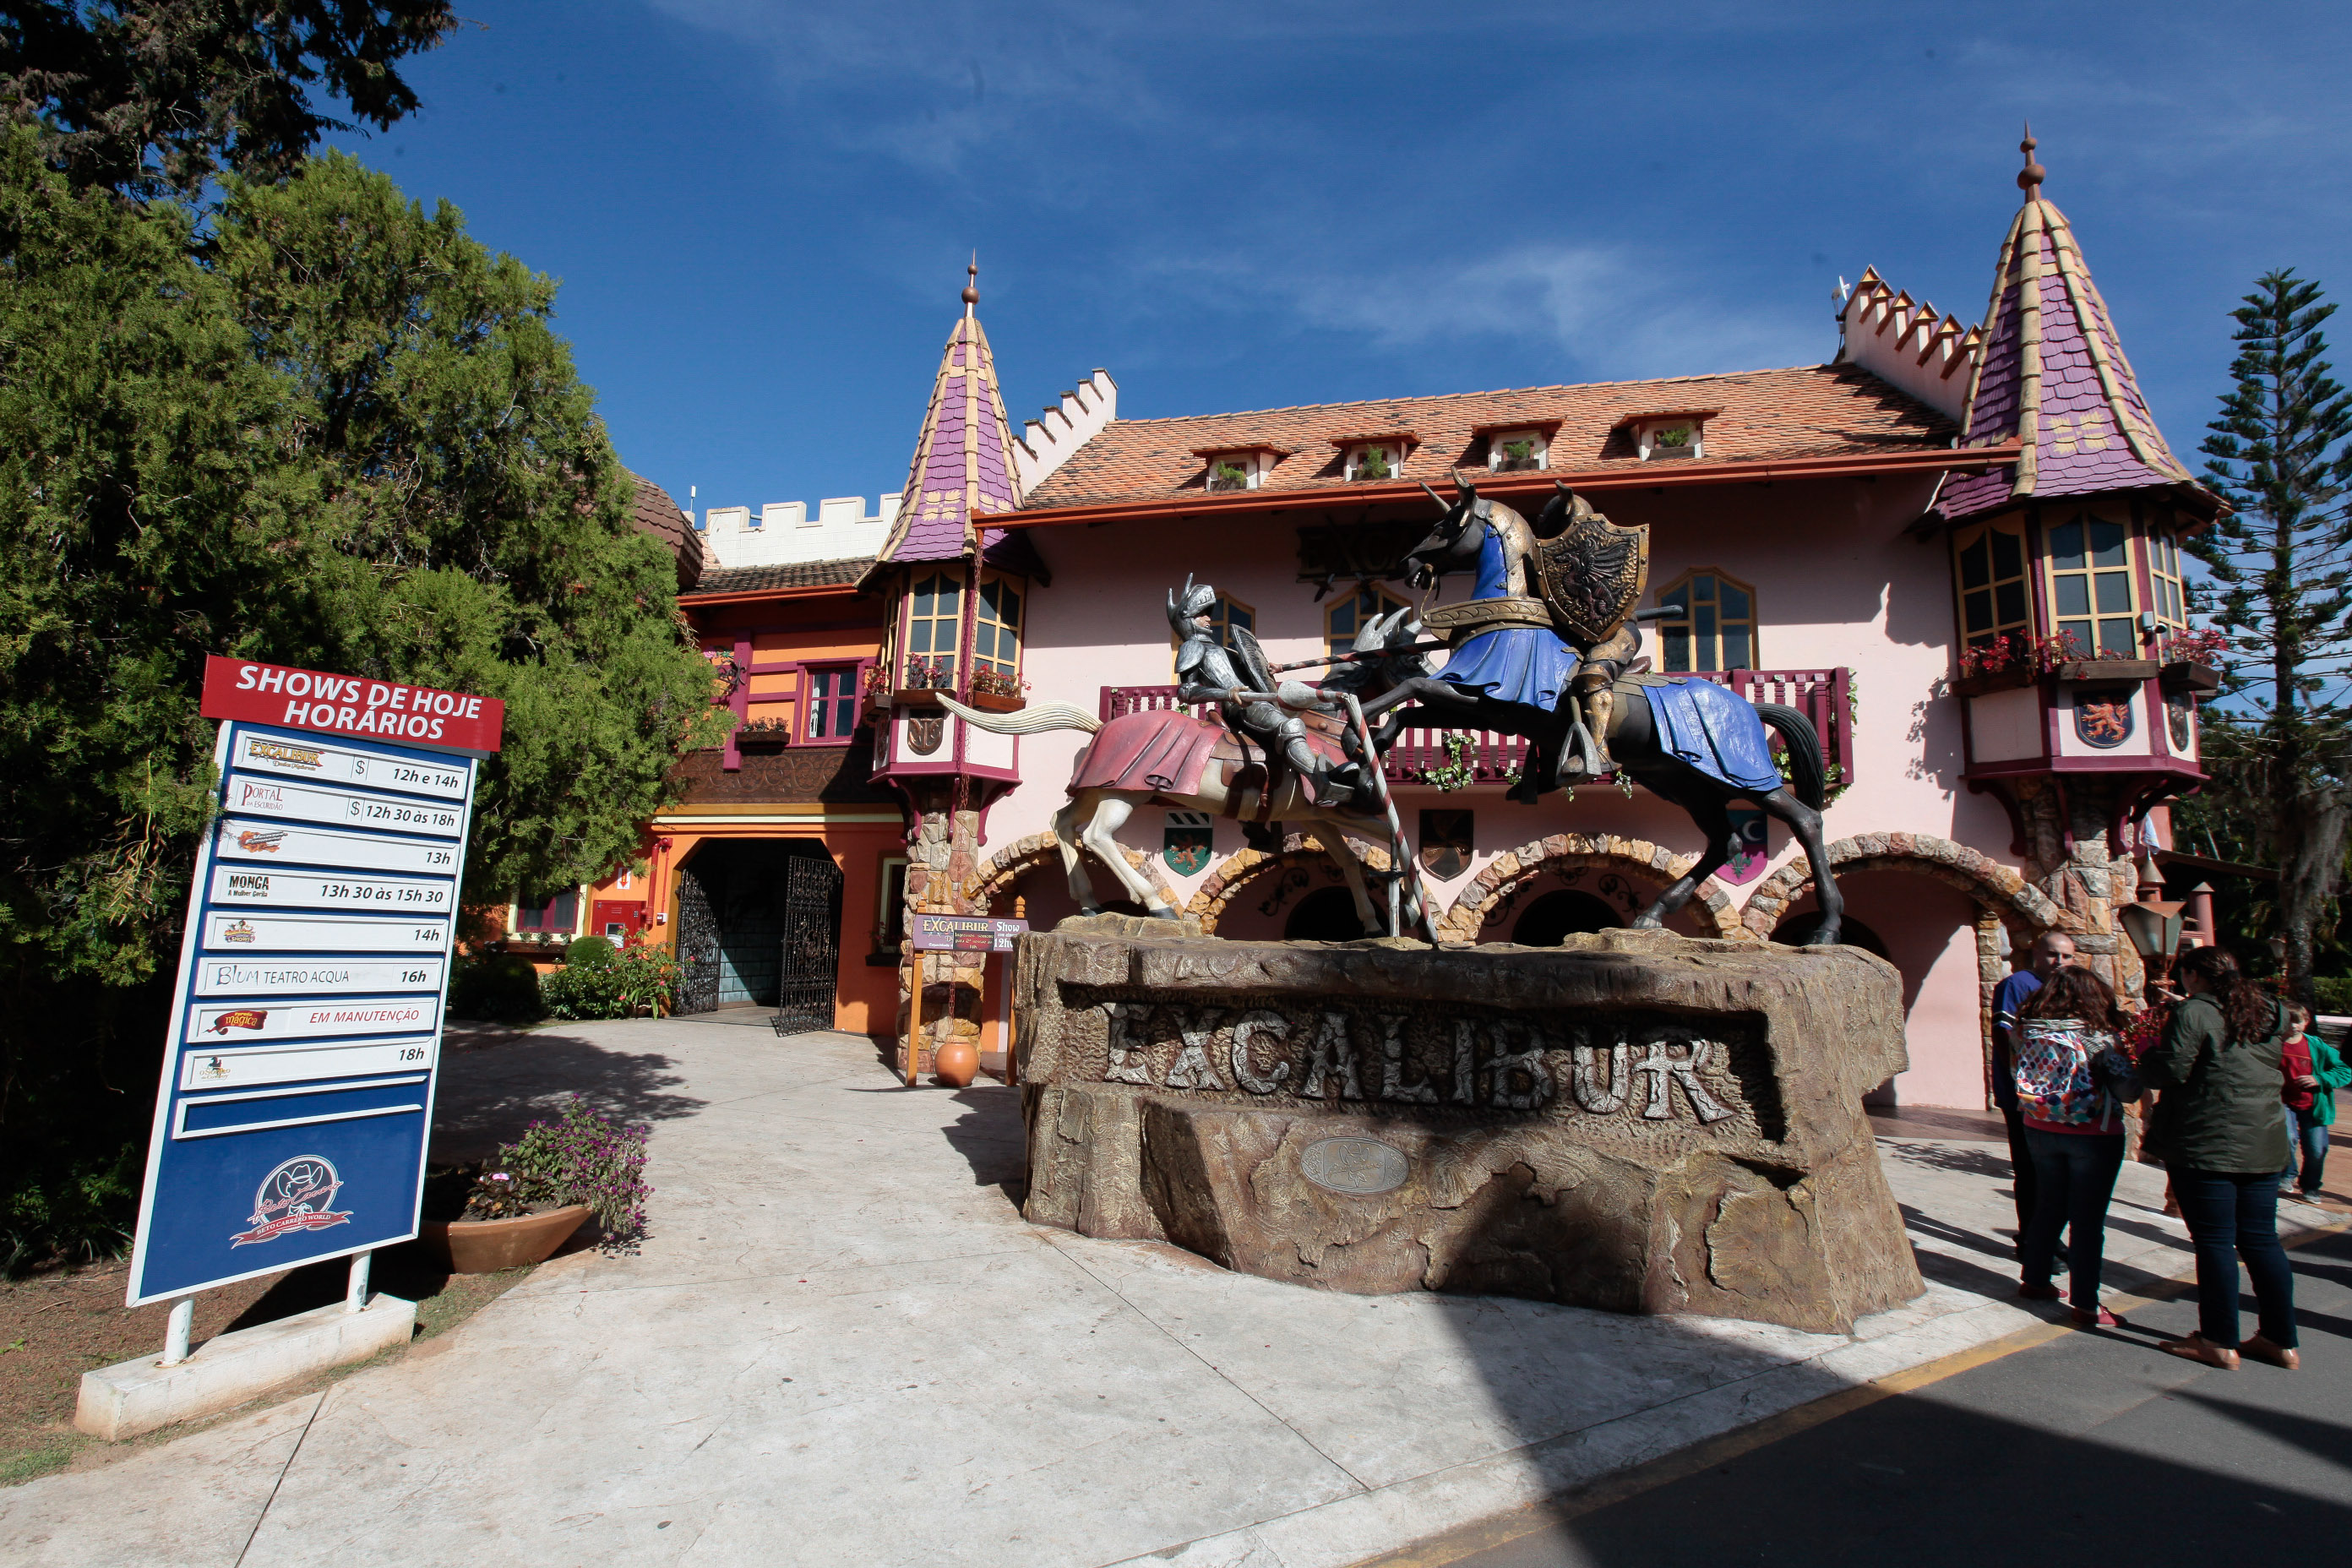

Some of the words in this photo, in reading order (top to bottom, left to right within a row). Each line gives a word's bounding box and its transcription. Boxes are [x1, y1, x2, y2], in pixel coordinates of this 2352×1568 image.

[236, 665, 362, 704] SHOWS
[368, 683, 408, 710] DE
[411, 690, 482, 720] HOJE
[283, 700, 444, 740] HORÁRIOS
[249, 743, 320, 765] EXCALIBUR
[356, 760, 366, 776] $
[393, 768, 419, 783] 12h
[421, 773, 430, 784] e
[434, 774, 459, 789] 14h
[254, 801, 283, 811] ESCURIDÃO
[351, 801, 361, 817] $
[366, 804, 390, 820] 12h
[393, 808, 411, 822] 30
[413, 809, 429, 824] às
[433, 813, 455, 827] 18h
[426, 852, 451, 865] 13h
[229, 875, 270, 890] MONGA
[320, 884, 349, 898] 13h
[351, 885, 373, 900] 30
[375, 886, 393, 901] às
[396, 888, 422, 902] 15h
[425, 890, 444, 903] 30
[414, 928, 440, 942] 14h
[996, 921, 1021, 933] Show
[264, 971, 308, 984] TEATRO
[310, 971, 350, 984] ACQUA
[400, 969, 427, 983] 16h
[225, 1015, 258, 1027] mágica
[309, 1012, 330, 1025] EM
[333, 1007, 420, 1024] MANUTENÇÃO
[399, 1048, 425, 1062] 18h
[1103, 1001, 1735, 1124] EXCALIBUR
[257, 1223, 275, 1235] BETO
[275, 1216, 307, 1228] CARRERO
